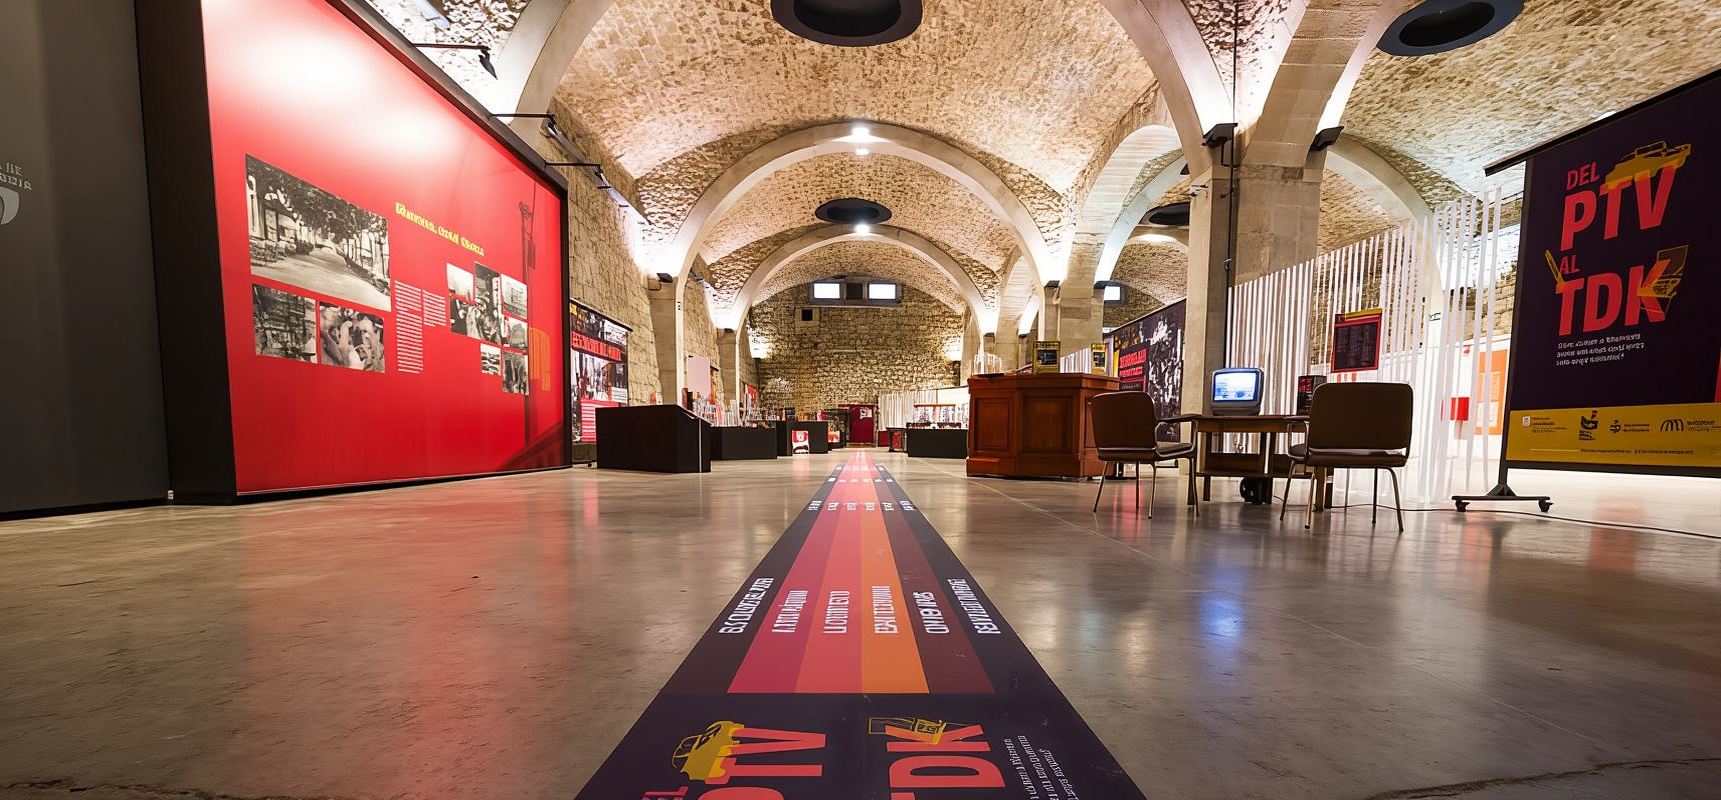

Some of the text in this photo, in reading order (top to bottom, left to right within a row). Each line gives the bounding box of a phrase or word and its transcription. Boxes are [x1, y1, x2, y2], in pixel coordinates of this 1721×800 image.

[1560, 160, 1680, 251] PTV
[1566, 162, 1600, 190] DEL
[1556, 259, 1671, 336] TDK
[1560, 255, 1580, 274] AL
[885, 725, 1006, 800] DK
